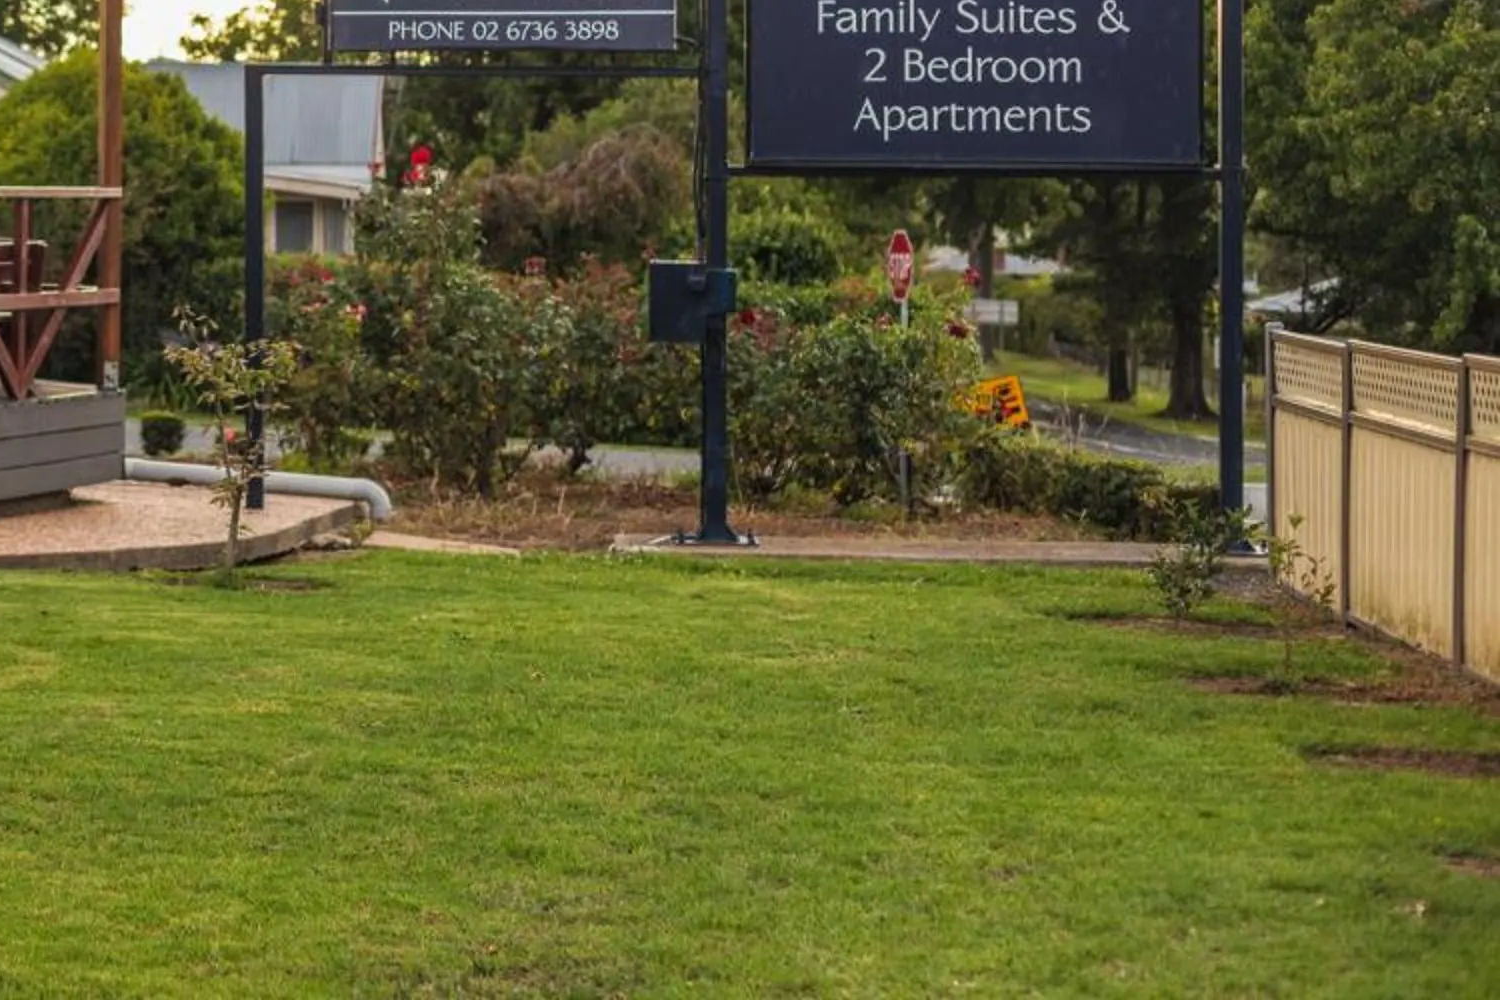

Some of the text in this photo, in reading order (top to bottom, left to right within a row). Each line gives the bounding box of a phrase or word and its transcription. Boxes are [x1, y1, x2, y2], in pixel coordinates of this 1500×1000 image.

[388, 20, 619, 41] PHONE 02 6736 3898
[1097, 0, 1131, 34] &
[864, 46, 1082, 84] 2 Bedroom
[853, 97, 1092, 142] Apartments
